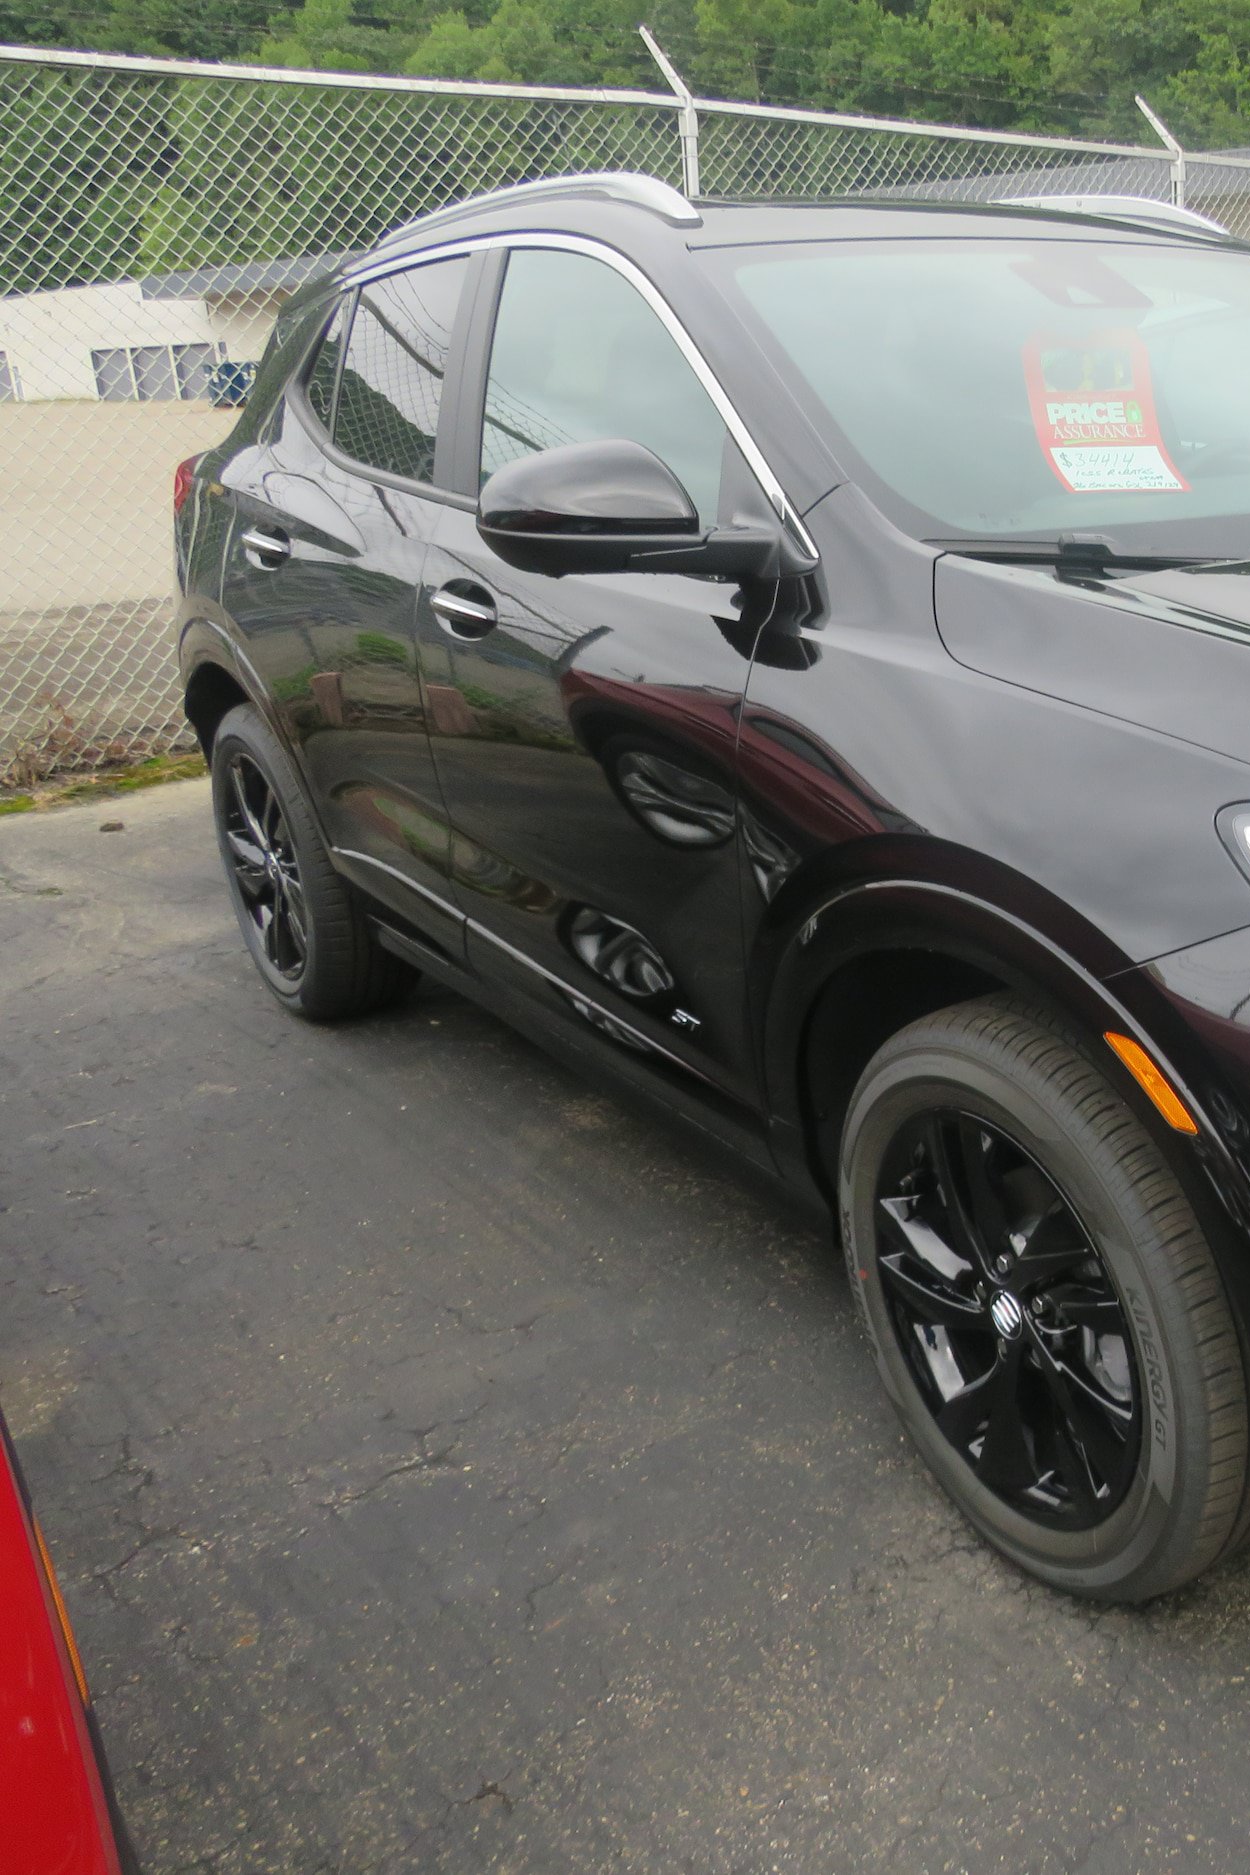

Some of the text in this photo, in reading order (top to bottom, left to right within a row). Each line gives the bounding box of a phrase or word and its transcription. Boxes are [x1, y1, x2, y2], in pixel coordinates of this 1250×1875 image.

[1046, 401, 1127, 425] PRICE
[1053, 423, 1146, 440] ASSURANCE
[1125, 1286, 1169, 1452] KINERGY GT
